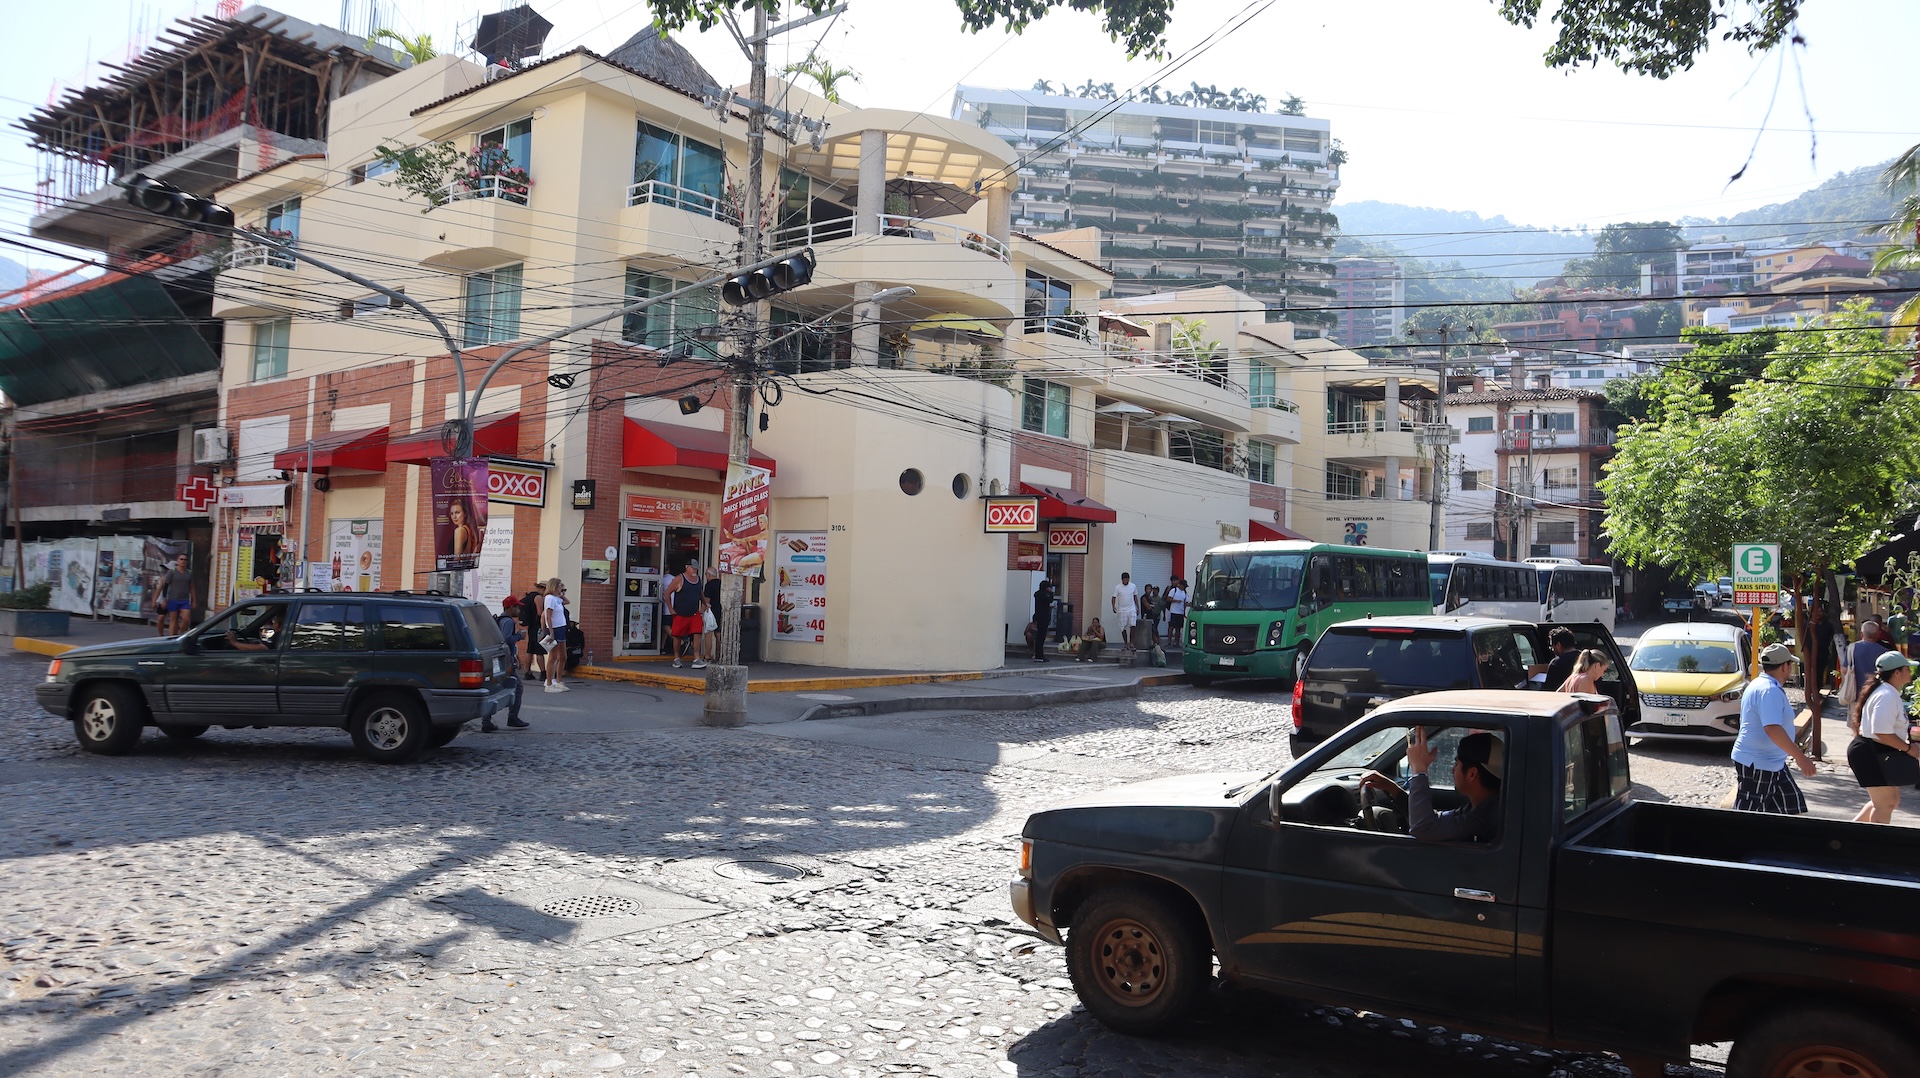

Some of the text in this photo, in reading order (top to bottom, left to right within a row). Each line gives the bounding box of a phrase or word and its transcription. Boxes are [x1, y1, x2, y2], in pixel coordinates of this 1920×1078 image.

[488, 473, 540, 496] OXXO
[723, 490, 769, 515] RAISE YOUR GLASS
[735, 511, 739, 519] A
[739, 504, 757, 517] TRIBUTE
[990, 504, 1034, 526] OXXO
[489, 527, 496, 535] de
[497, 527, 513, 535] forma
[1050, 530, 1086, 545] OXXO
[492, 538, 510, 546] segura
[1748, 550, 1764, 571] E
[804, 574, 825, 586] $40
[809, 597, 826, 607] $59
[805, 619, 825, 631] $40
